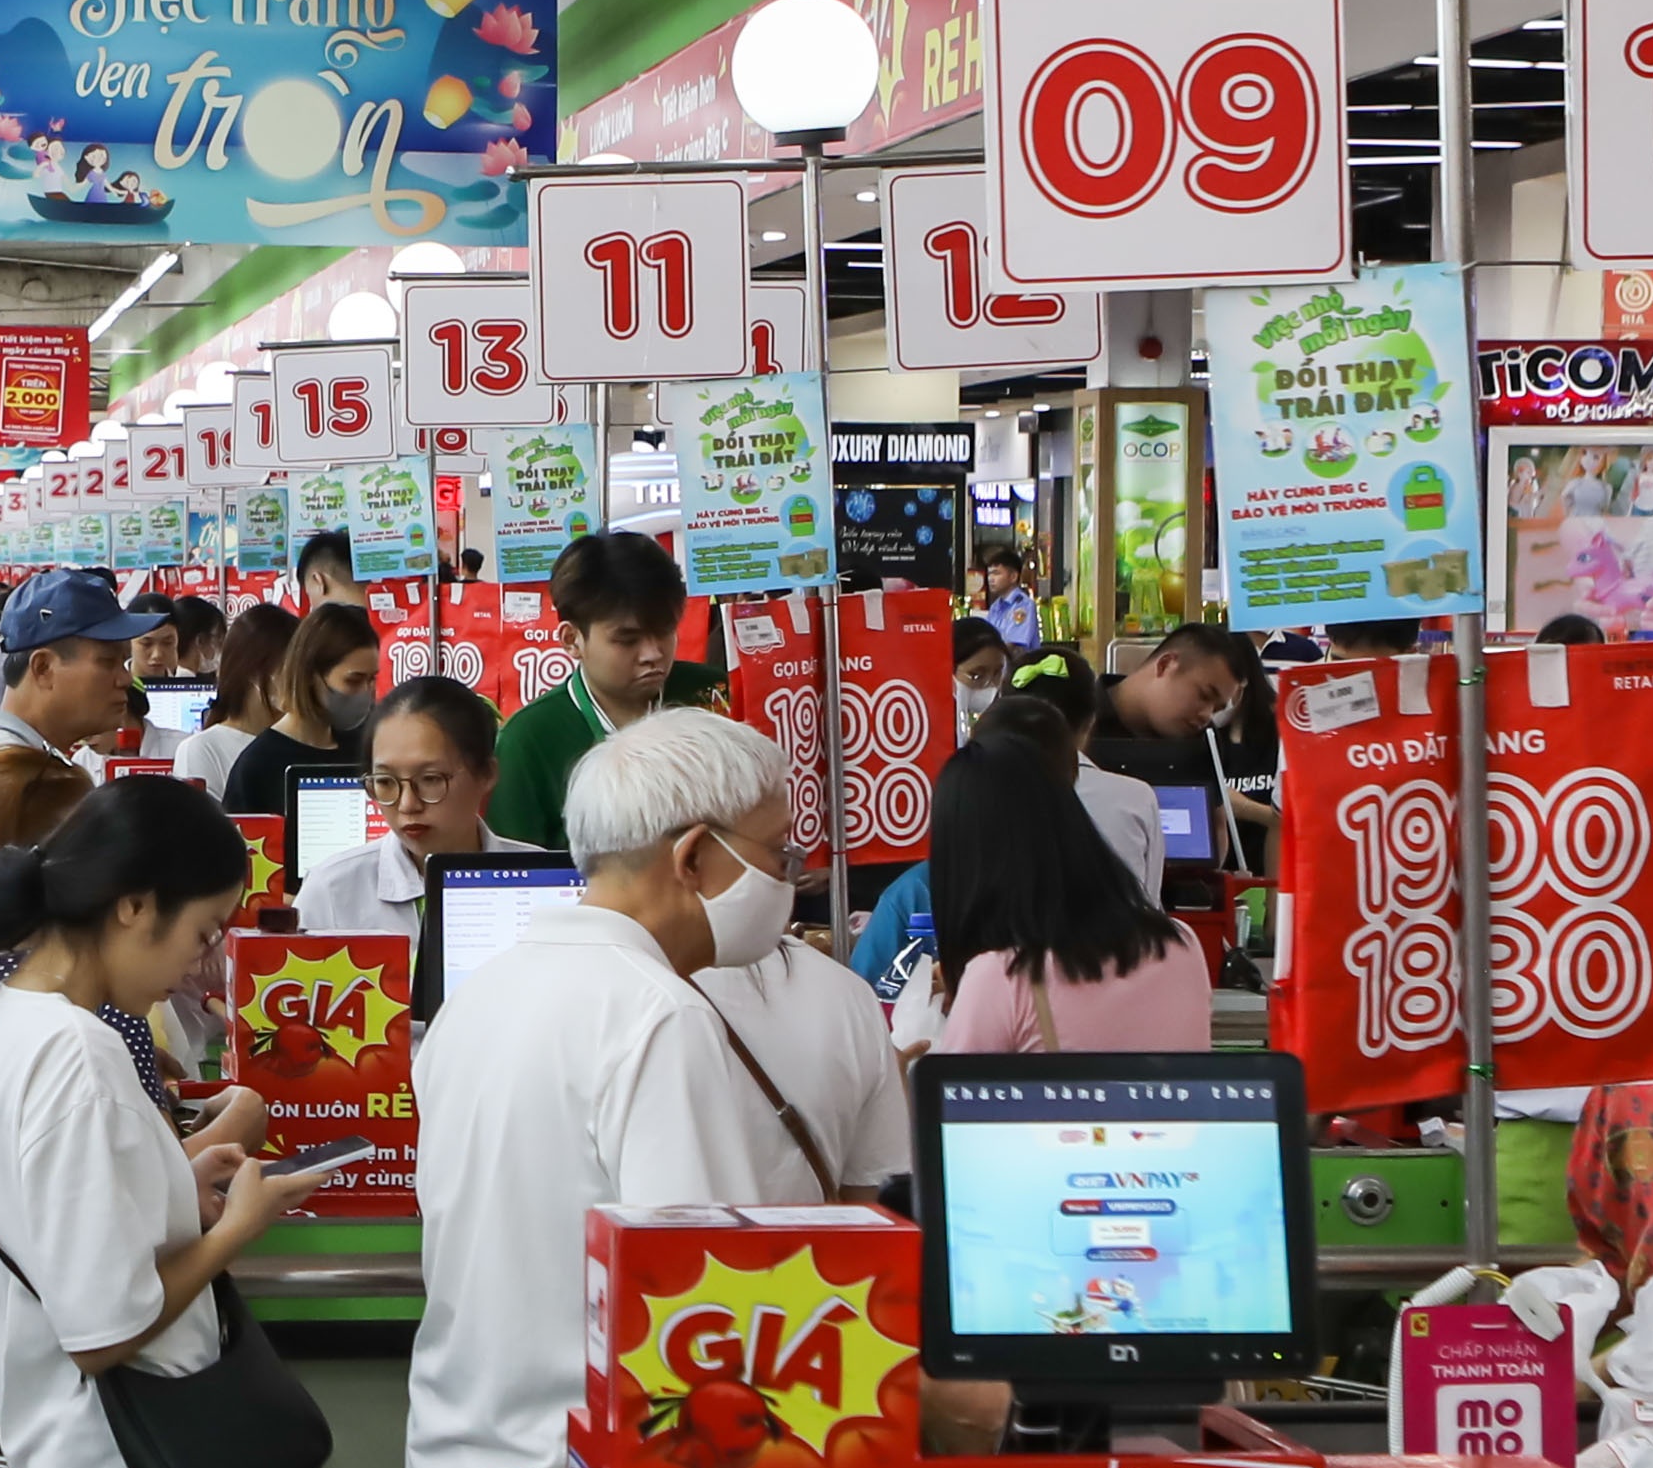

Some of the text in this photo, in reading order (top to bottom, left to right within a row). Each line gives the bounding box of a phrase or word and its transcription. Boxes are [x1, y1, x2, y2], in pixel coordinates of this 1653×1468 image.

[76, 48, 149, 102] vẹn
[1019, 32, 1322, 218] 09
[585, 229, 696, 341] 11
[429, 319, 528, 395] 13
[1336, 358, 1416, 384] THAY
[6, 390, 57, 405] 2.000
[293, 377, 372, 437] 15
[1277, 381, 1415, 419] TRÁI ĐẤT
[749, 431, 796, 448] THAY
[886, 434, 971, 463] DIAMOND
[1124, 442, 1180, 459] OCOP
[713, 449, 755, 469] TRÁI
[1330, 482, 1368, 496] BIG C
[1347, 730, 1447, 772] GỌI ĐẶT
[264, 969, 374, 1039] GIÁ
[305, 1082, 413, 1118] LUÔN RẺ
[944, 1082, 1273, 1103] Khách hàng tiếp theo
[657, 1293, 859, 1411] GIÁ
[1439, 1340, 1538, 1365] CHẤP NHẬN
[1432, 1362, 1491, 1380] THANH
